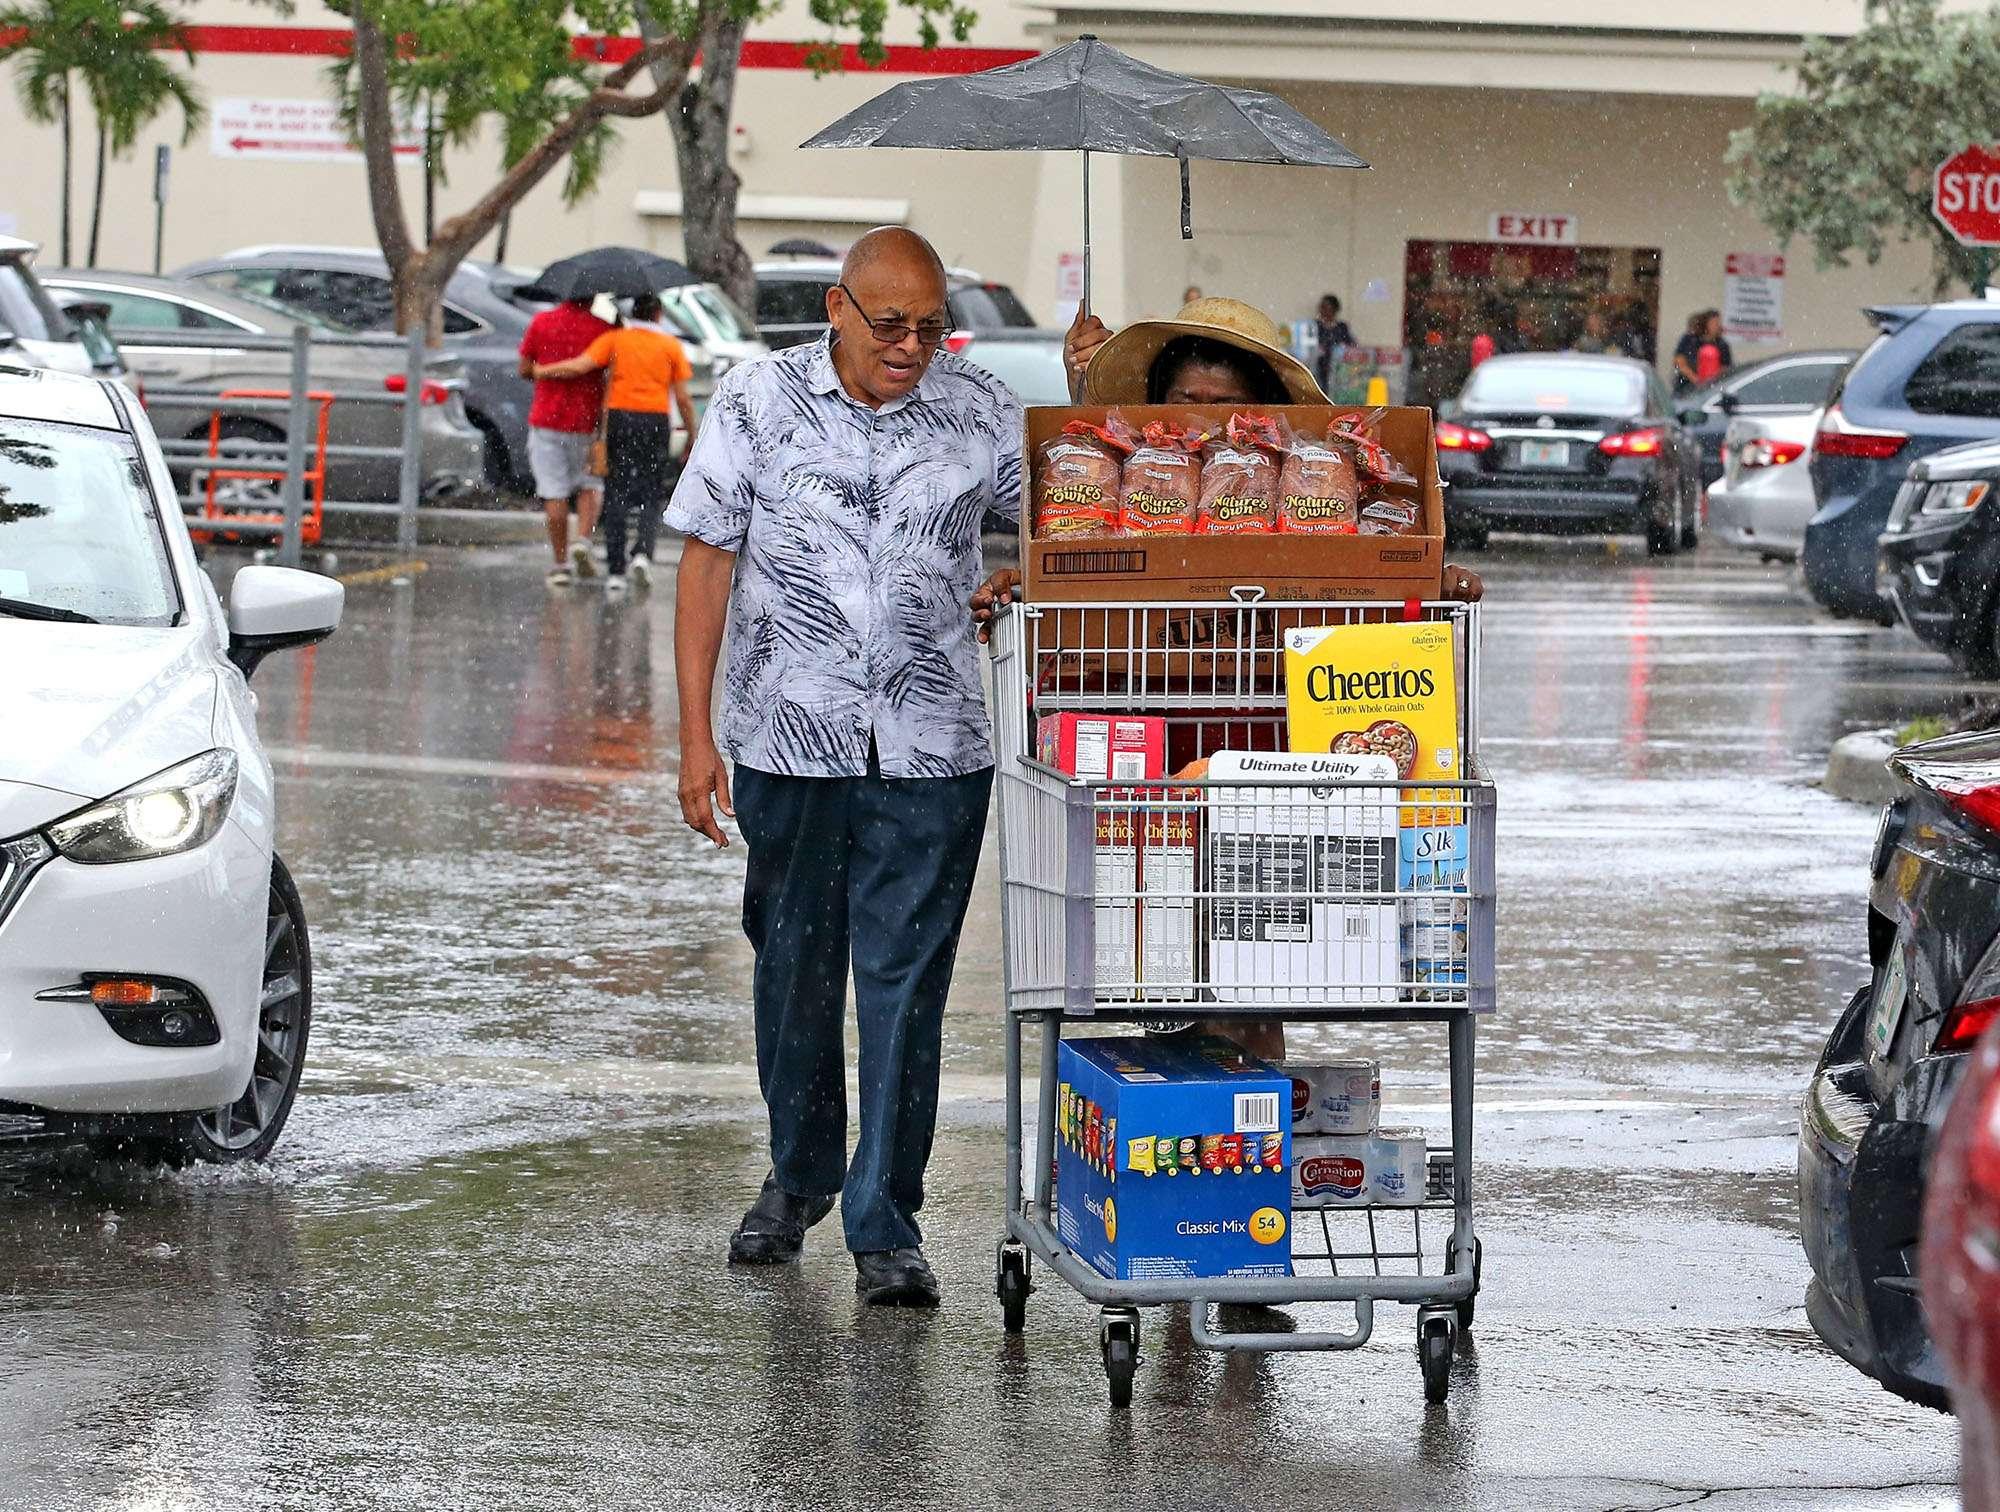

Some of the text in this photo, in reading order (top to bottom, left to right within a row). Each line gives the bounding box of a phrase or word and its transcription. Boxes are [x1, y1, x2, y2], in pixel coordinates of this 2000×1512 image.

[1942, 172, 2000, 213] STO
[1497, 216, 1567, 239] EXIT
[1044, 483, 1102, 501] Nature's
[1053, 490, 1086, 503] Own
[1127, 490, 1187, 509] Nature's
[1140, 500, 1174, 515] Own
[1210, 493, 1269, 510] Nature's
[1284, 494, 1346, 512] Nature's
[1127, 511, 1153, 528] Honey
[1219, 504, 1255, 520] Own
[1296, 505, 1334, 520] Own
[1383, 507, 1408, 519] FLORIDA
[1206, 521, 1235, 531] Honey
[1286, 520, 1343, 532] Honey Wheat
[1411, 634, 1448, 645] Gluten Free
[1306, 664, 1435, 703] Cheerios
[1336, 702, 1425, 715] 100% Whole Grain Oats
[1239, 757, 1360, 776] Ultimate Utility
[1416, 830, 1453, 857] Slk
[1303, 1163, 1362, 1182] Carnation
[1176, 1217, 1276, 1235] Classic Mix 54
